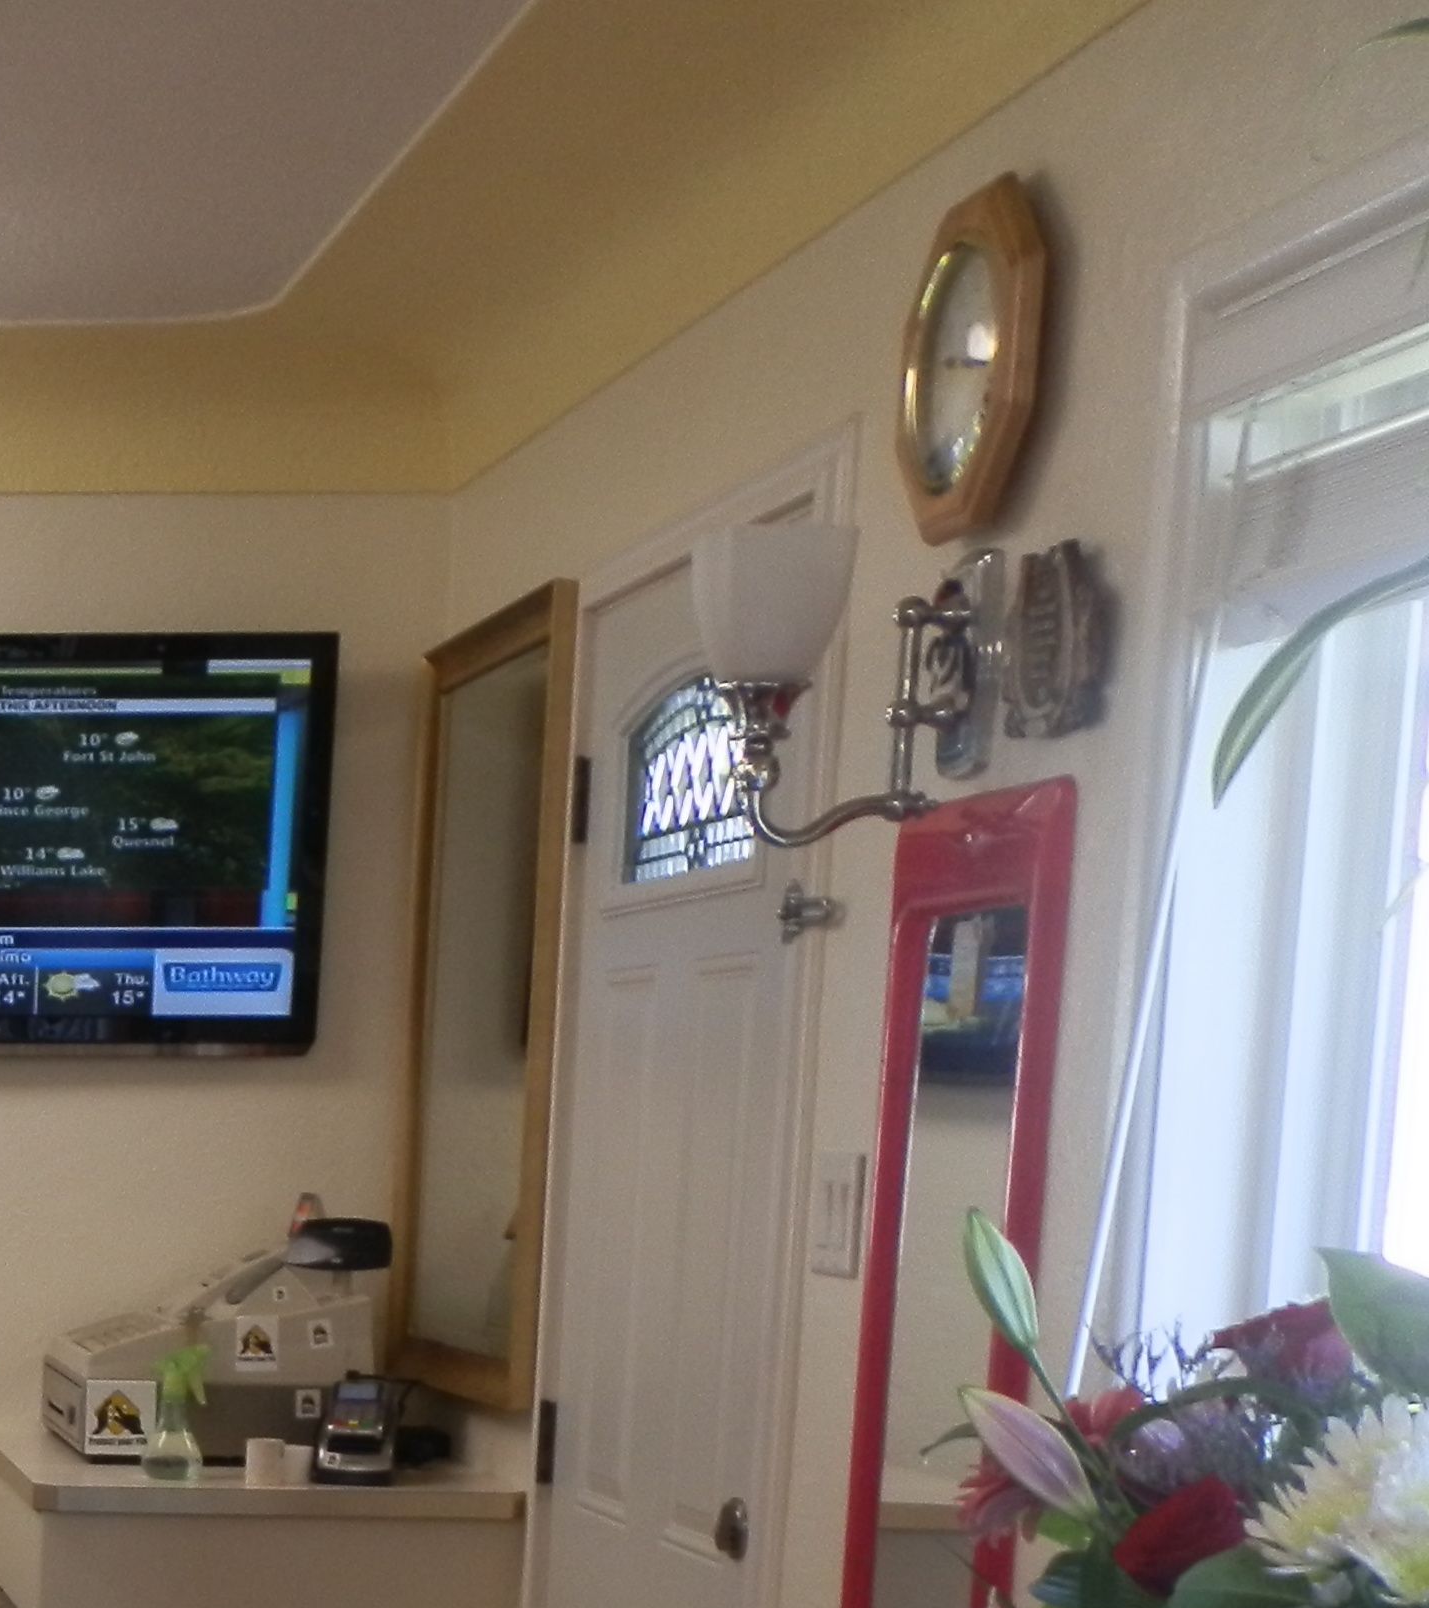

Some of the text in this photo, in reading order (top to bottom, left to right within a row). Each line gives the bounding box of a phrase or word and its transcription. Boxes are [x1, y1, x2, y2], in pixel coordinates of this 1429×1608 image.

[63, 751, 156, 763] Fort St John
[34, 804, 89, 819] George
[112, 835, 175, 849] Quesnel
[0, 865, 106, 877] Williams Lake
[114, 972, 149, 986] Thu.
